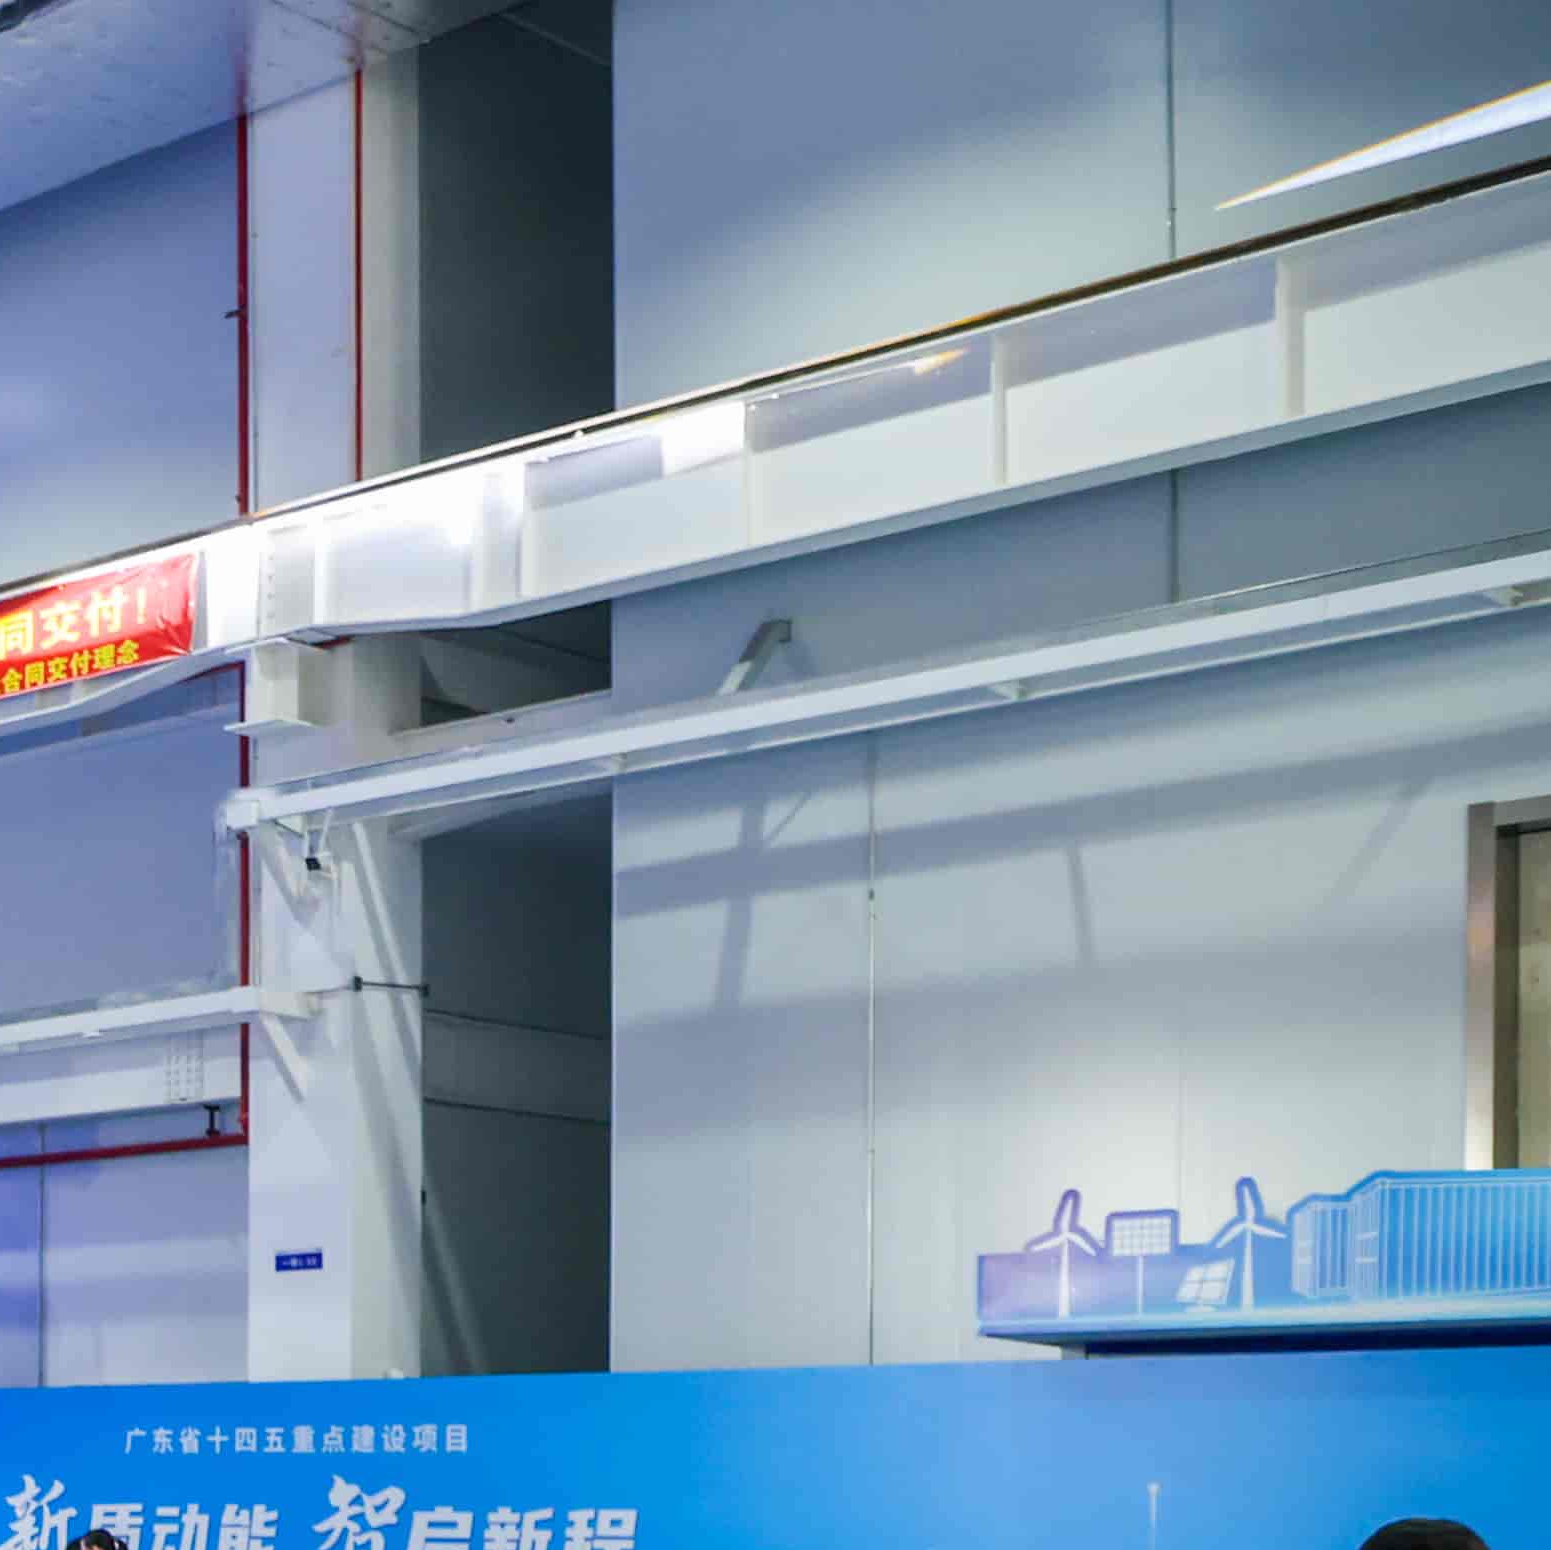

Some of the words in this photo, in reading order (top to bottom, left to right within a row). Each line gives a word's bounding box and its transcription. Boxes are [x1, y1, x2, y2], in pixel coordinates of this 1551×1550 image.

[124, 1423, 469, 1455] 广东省十四五重点建设项目
